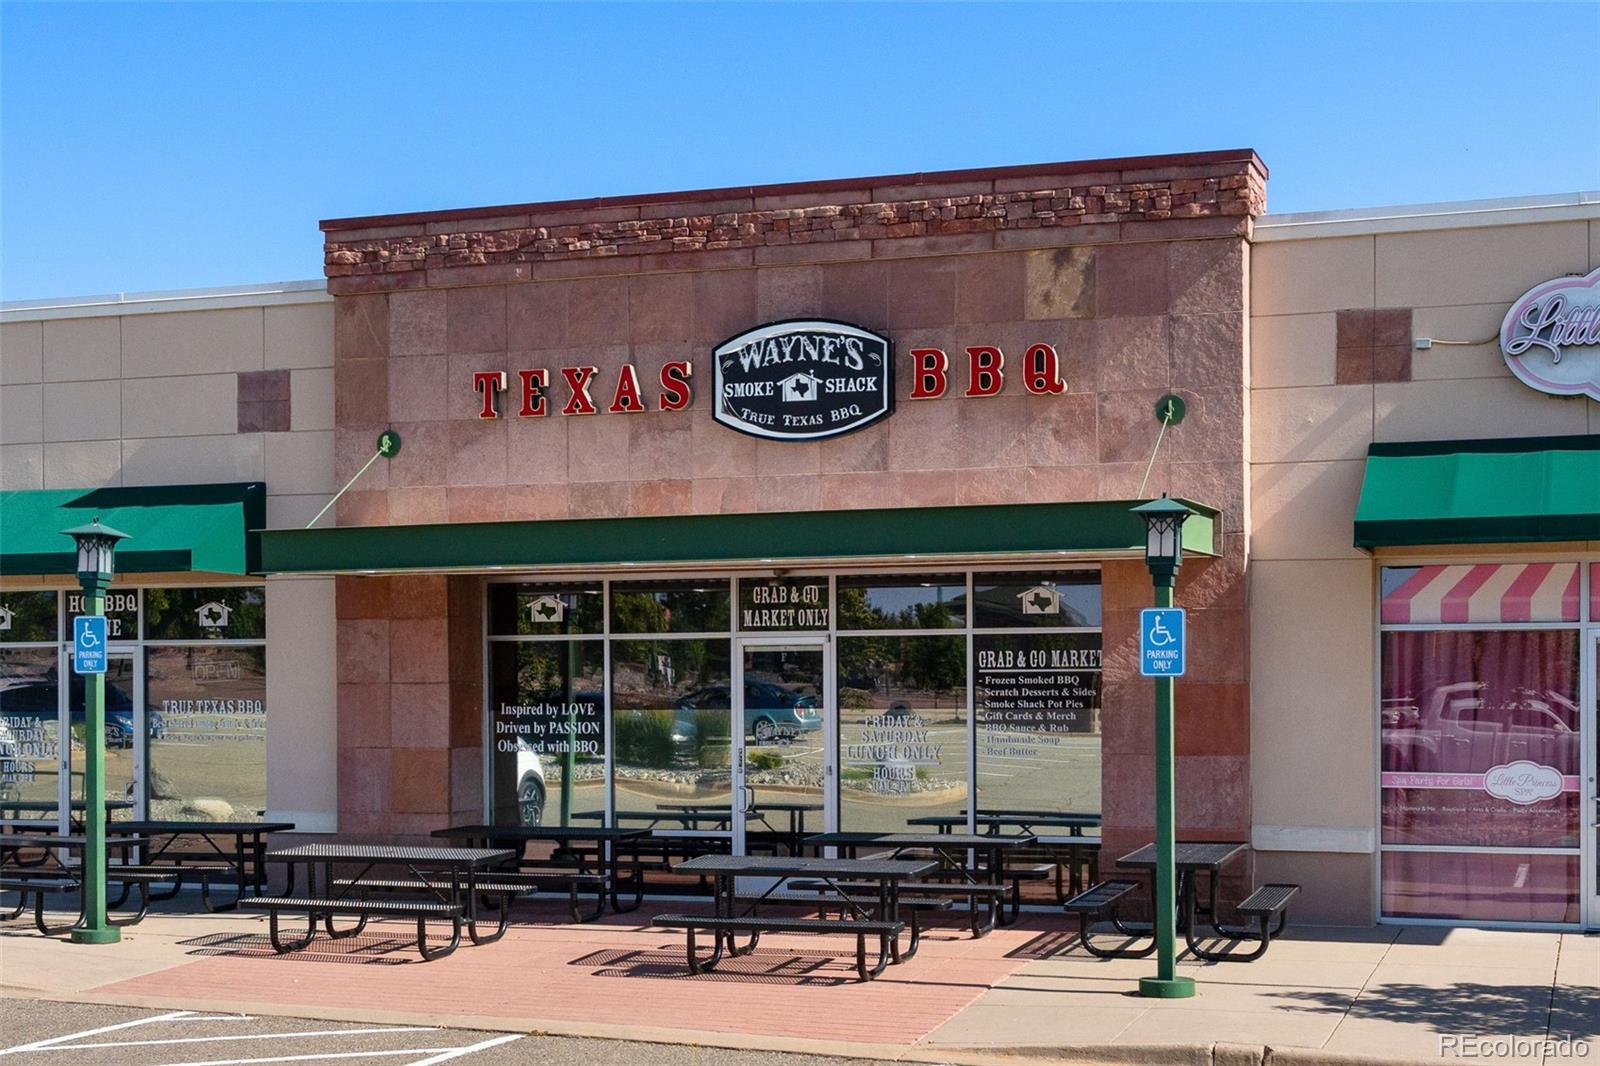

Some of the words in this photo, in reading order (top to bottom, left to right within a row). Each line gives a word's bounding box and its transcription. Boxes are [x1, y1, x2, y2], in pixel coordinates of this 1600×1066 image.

[737, 335, 864, 373] WAYNE'S
[910, 343, 1068, 400] BBQ
[473, 361, 692, 420] TEXAS
[725, 381, 774, 398] SMOKE
[825, 377, 877, 393] SHACK
[831, 404, 863, 422] BBQ
[753, 586, 787, 603] GRAB
[791, 586, 800, 603] &
[803, 585, 819, 603] GO
[104, 594, 138, 611] BBQ
[744, 609, 795, 627] MARKET
[798, 608, 828, 626] ONLY
[79, 651, 102, 659] PARKING
[979, 650, 1014, 668] GRAB
[1017, 650, 1026, 668] &
[1030, 650, 1046, 667] GO
[1147, 650, 1179, 659] PARKING
[1153, 660, 1172, 669] ONLY
[985, 675, 1016, 685] Frozen
[1018, 675, 1055, 685] Smoked
[1057, 675, 1080, 686] BBQ
[985, 688, 1019, 697] Scratch
[1022, 688, 1059, 697] Desserts
[1061, 688, 1070, 697] &
[1073, 688, 1097, 697] Sides
[162, 700, 194, 714] TRUE
[196, 700, 235, 714] TEXAS
[237, 700, 264, 714] BBQ
[501, 703, 543, 718] Inspired
[546, 703, 558, 718] by
[561, 703, 595, 715] LOVE
[985, 700, 1015, 709] Smoke
[1017, 700, 1045, 709] Shack
[1048, 700, 1063, 709] Pot
[1065, 700, 1084, 709] Pies
[34, 716, 41, 728] &
[864, 715, 910, 728] FRIDAY
[985, 711, 1003, 720] Gift
[1005, 711, 1033, 720] Cards
[1035, 712, 1043, 720] &
[1048, 711, 1077, 720] Merch
[496, 721, 531, 734] Driven
[533, 722, 546, 737] by
[549, 721, 600, 734] PASSION
[985, 723, 1007, 733] BBQ
[1009, 723, 1035, 732] Sauce
[1038, 723, 1047, 732] &
[1050, 723, 1069, 732] Rub
[862, 730, 928, 743] SATURDAY
[547, 740, 570, 752] with
[573, 740, 598, 755] BBQ
[847, 745, 898, 760] LUNCH
[902, 745, 942, 760] ONLY
[3, 761, 35, 773] HOURS
[873, 767, 914, 781] HOURS
